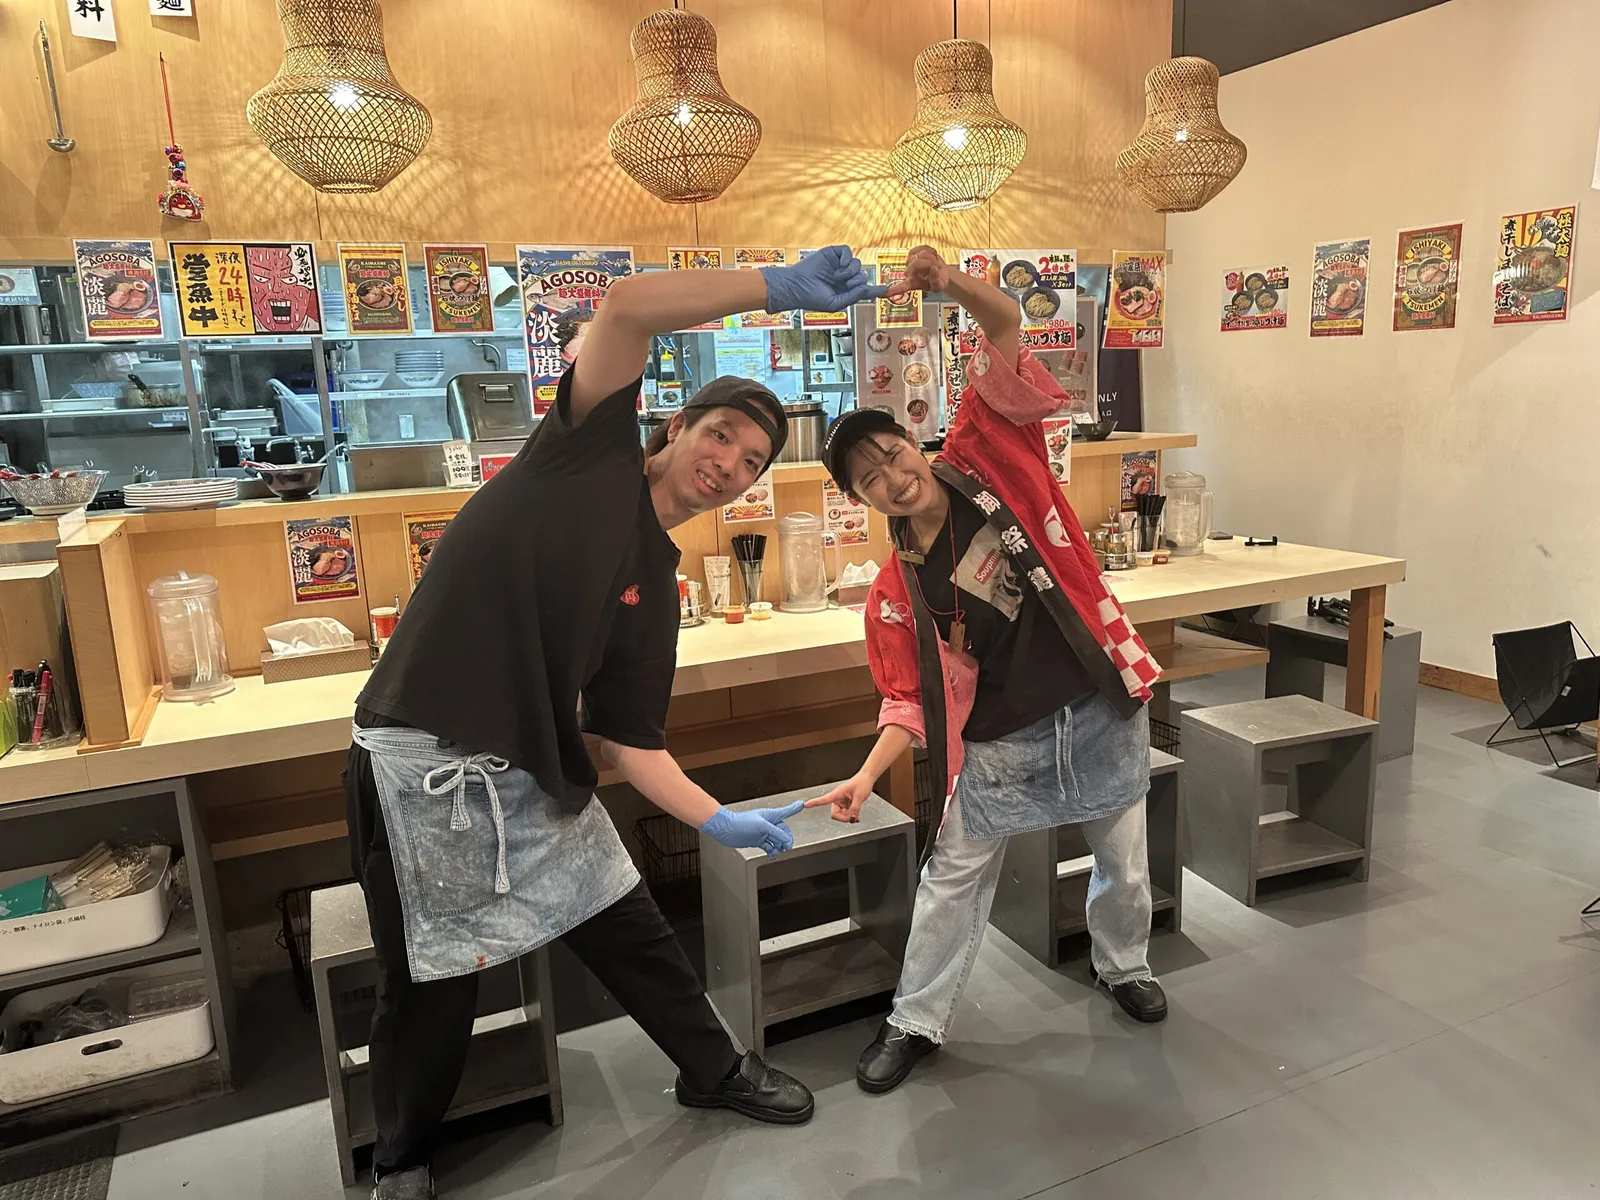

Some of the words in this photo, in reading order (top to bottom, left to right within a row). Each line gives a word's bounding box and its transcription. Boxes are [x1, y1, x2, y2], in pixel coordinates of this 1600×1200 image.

[1554, 212, 1572, 258] 極太麺
[1410, 240, 1446, 254] ISHIYAKI
[89, 253, 141, 266] AGOSOBA
[215, 252, 241, 264] 深夜
[440, 256, 472, 267] ISHIYAKI
[1141, 256, 1163, 271] MAX
[1323, 254, 1360, 268] AGOSOBA
[1496, 219, 1516, 308] 煮干しまそば
[219, 267, 243, 285] 24
[83, 277, 108, 316] 淡麗
[182, 253, 219, 328] 営魚中
[1313, 278, 1328, 316] 淡麗
[445, 302, 481, 316] TSUKEMEN
[1406, 296, 1444, 311] TSUKEMEN
[1044, 319, 1070, 328] 1,980円
[528, 310, 564, 378] 淡麗
[297, 527, 340, 541] AGOSOBA
[292, 549, 314, 583] 淡麗
